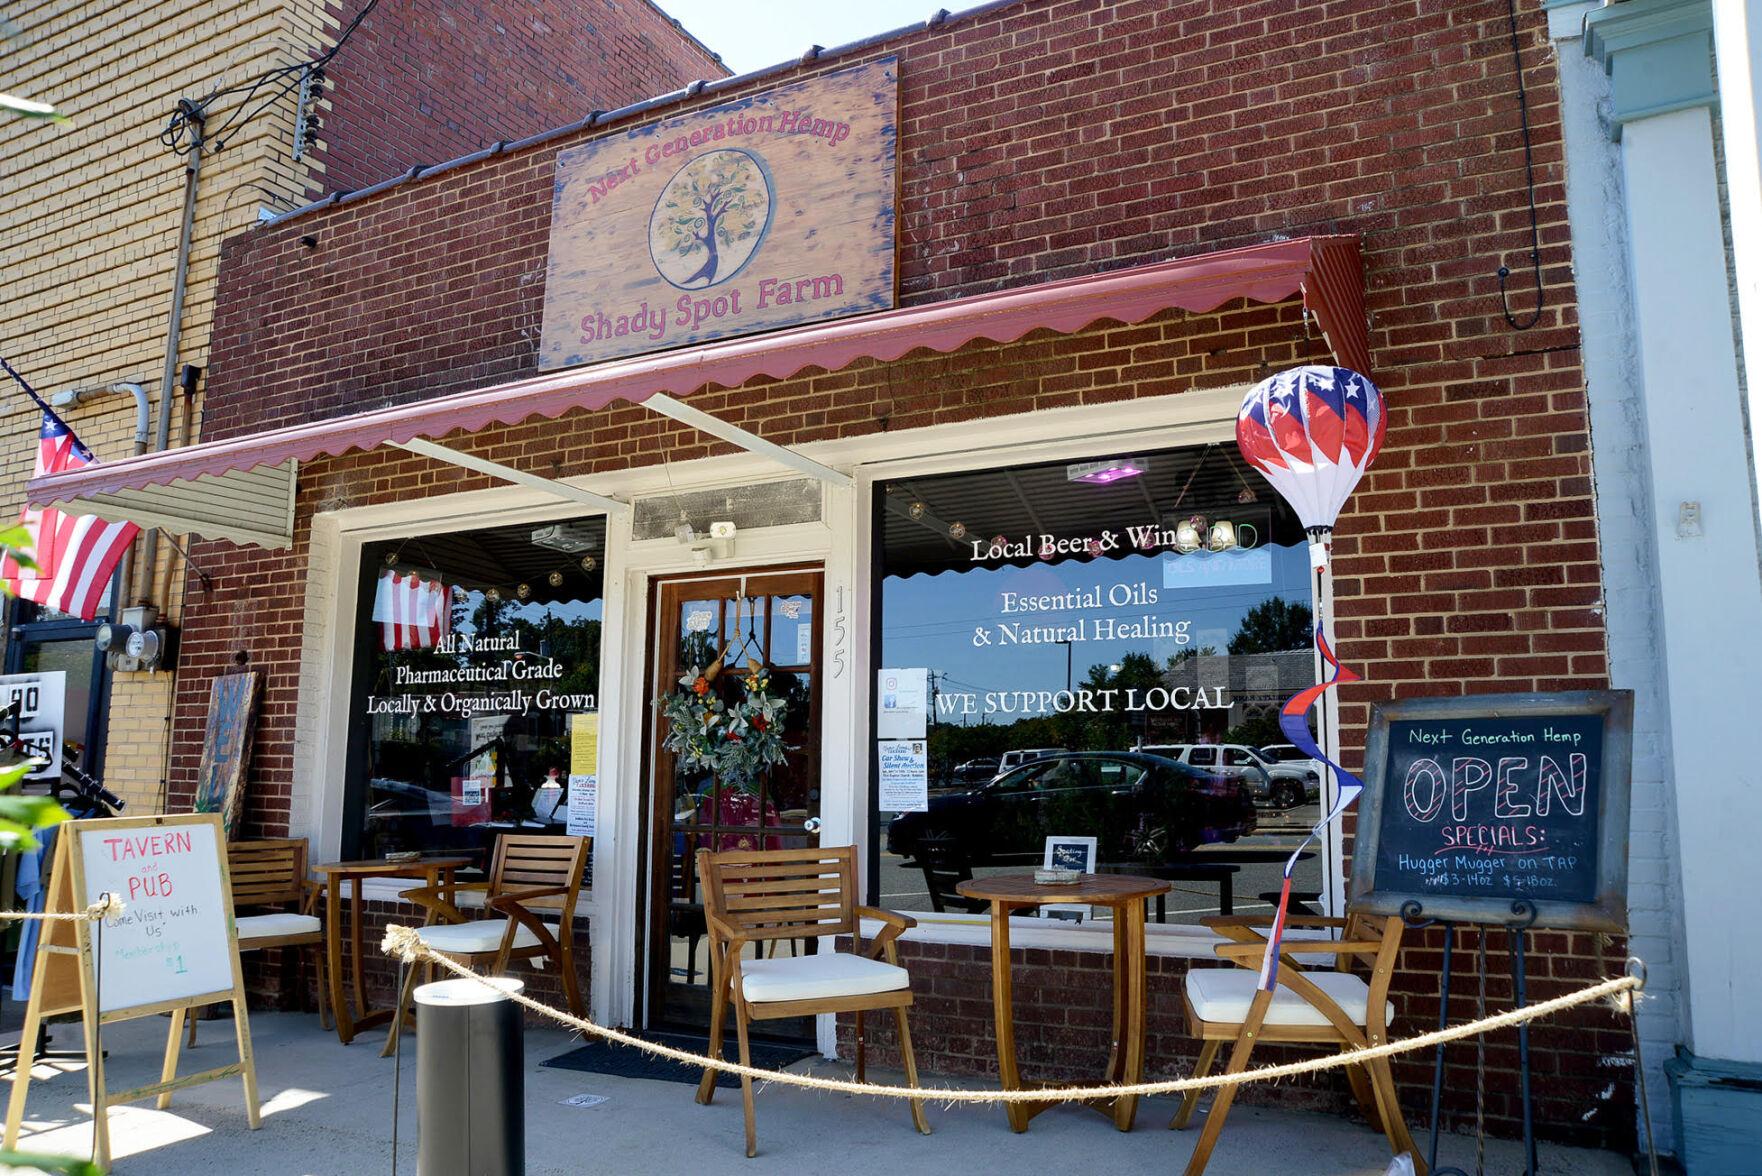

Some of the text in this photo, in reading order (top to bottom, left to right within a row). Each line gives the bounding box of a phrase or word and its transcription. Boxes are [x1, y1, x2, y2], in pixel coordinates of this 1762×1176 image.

[586, 111, 851, 204] Next Generation Hemp
[580, 273, 844, 345] Shady Spot Farm
[970, 524, 1181, 562] Local Beer & Win
[1001, 583, 1158, 614] Essential Oils
[433, 630, 520, 654] All Natural
[832, 585, 845, 680] 155
[972, 616, 1191, 647] & Natural Healing
[395, 658, 563, 685] Pharmaceutical Grade
[366, 689, 595, 719] Locally & Organically Grown
[935, 686, 1235, 716] WE SUPPORT LOCAL
[1409, 727, 1581, 746] Next Generation Hemp
[1403, 753, 1586, 823] OPEN
[104, 831, 192, 861] TAVERN
[1441, 825, 1546, 846] SPECIALS:
[141, 862, 158, 873] and
[1399, 854, 1577, 875] Hugger Mugger on TAP
[128, 873, 173, 900] PUB
[134, 909, 163, 923] Visit
[170, 904, 198, 917] with
